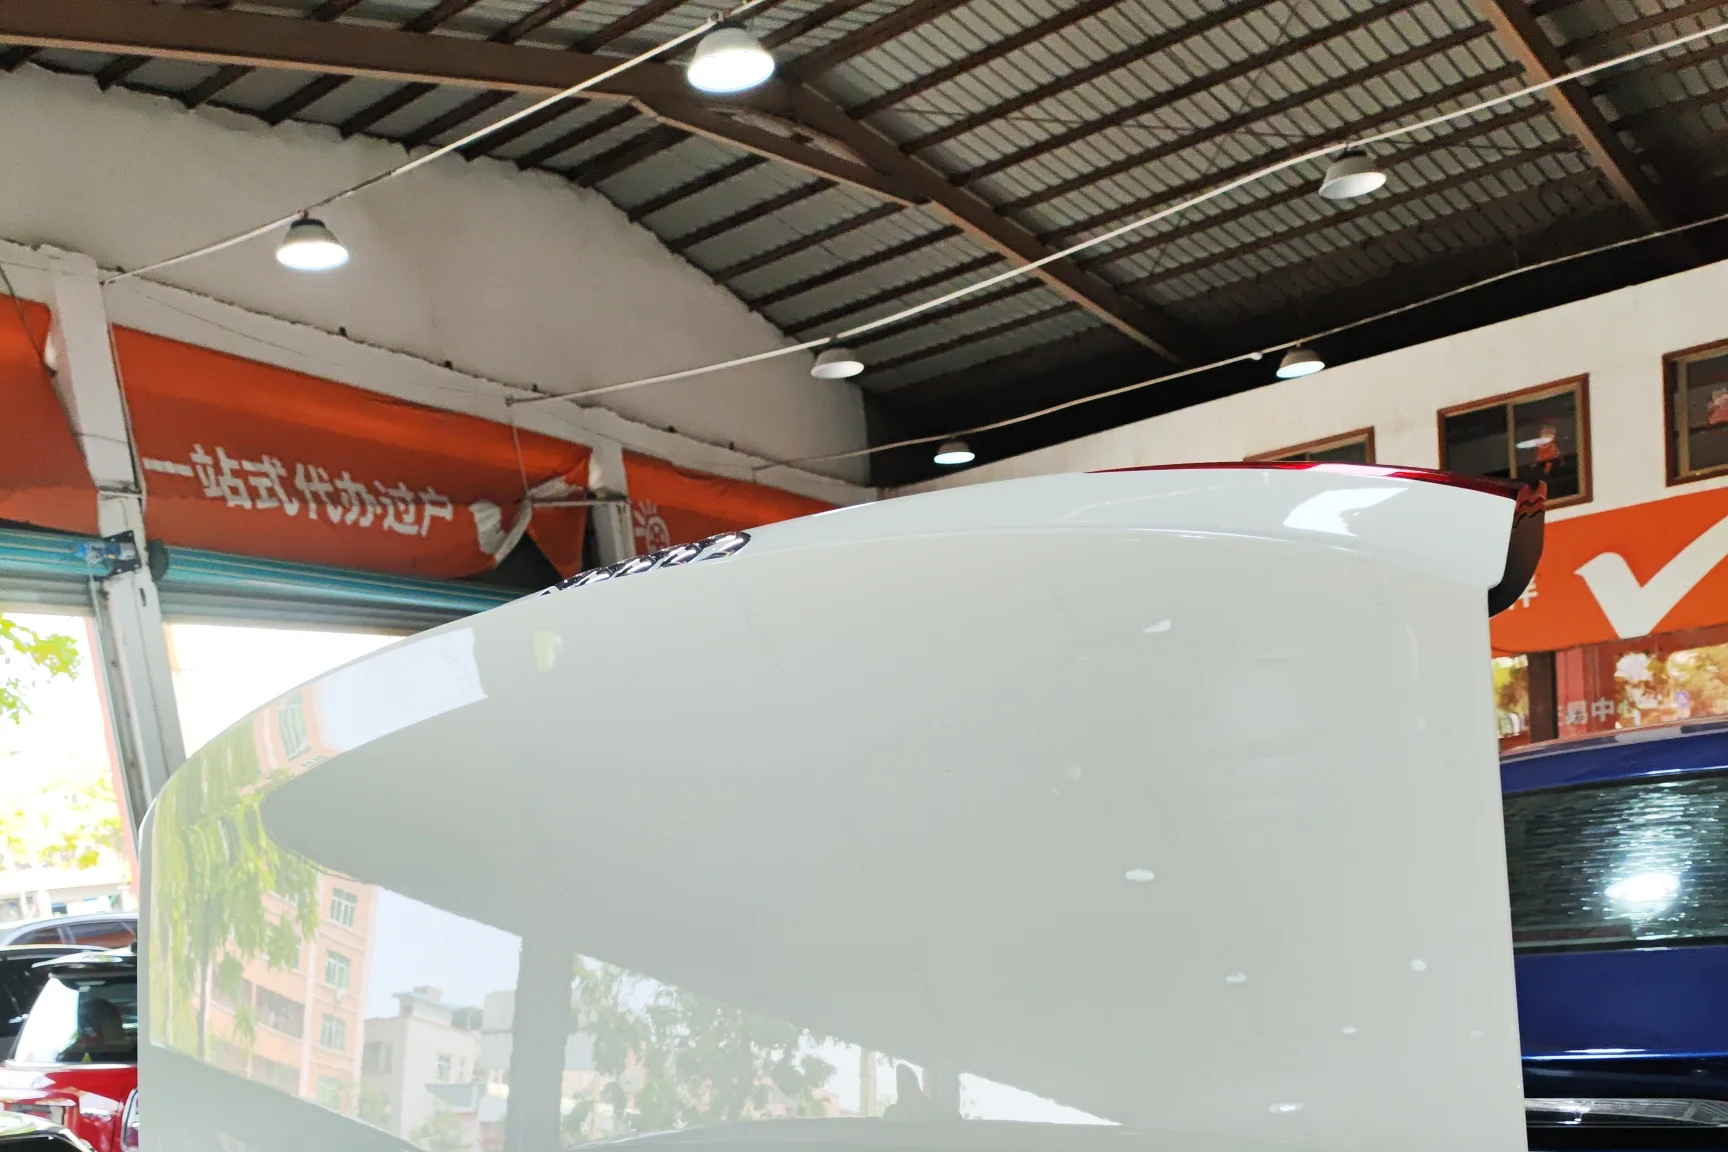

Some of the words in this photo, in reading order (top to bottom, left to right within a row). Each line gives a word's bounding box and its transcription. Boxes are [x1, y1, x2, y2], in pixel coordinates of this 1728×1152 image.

[143, 444, 453, 537] 一站式代办过户
